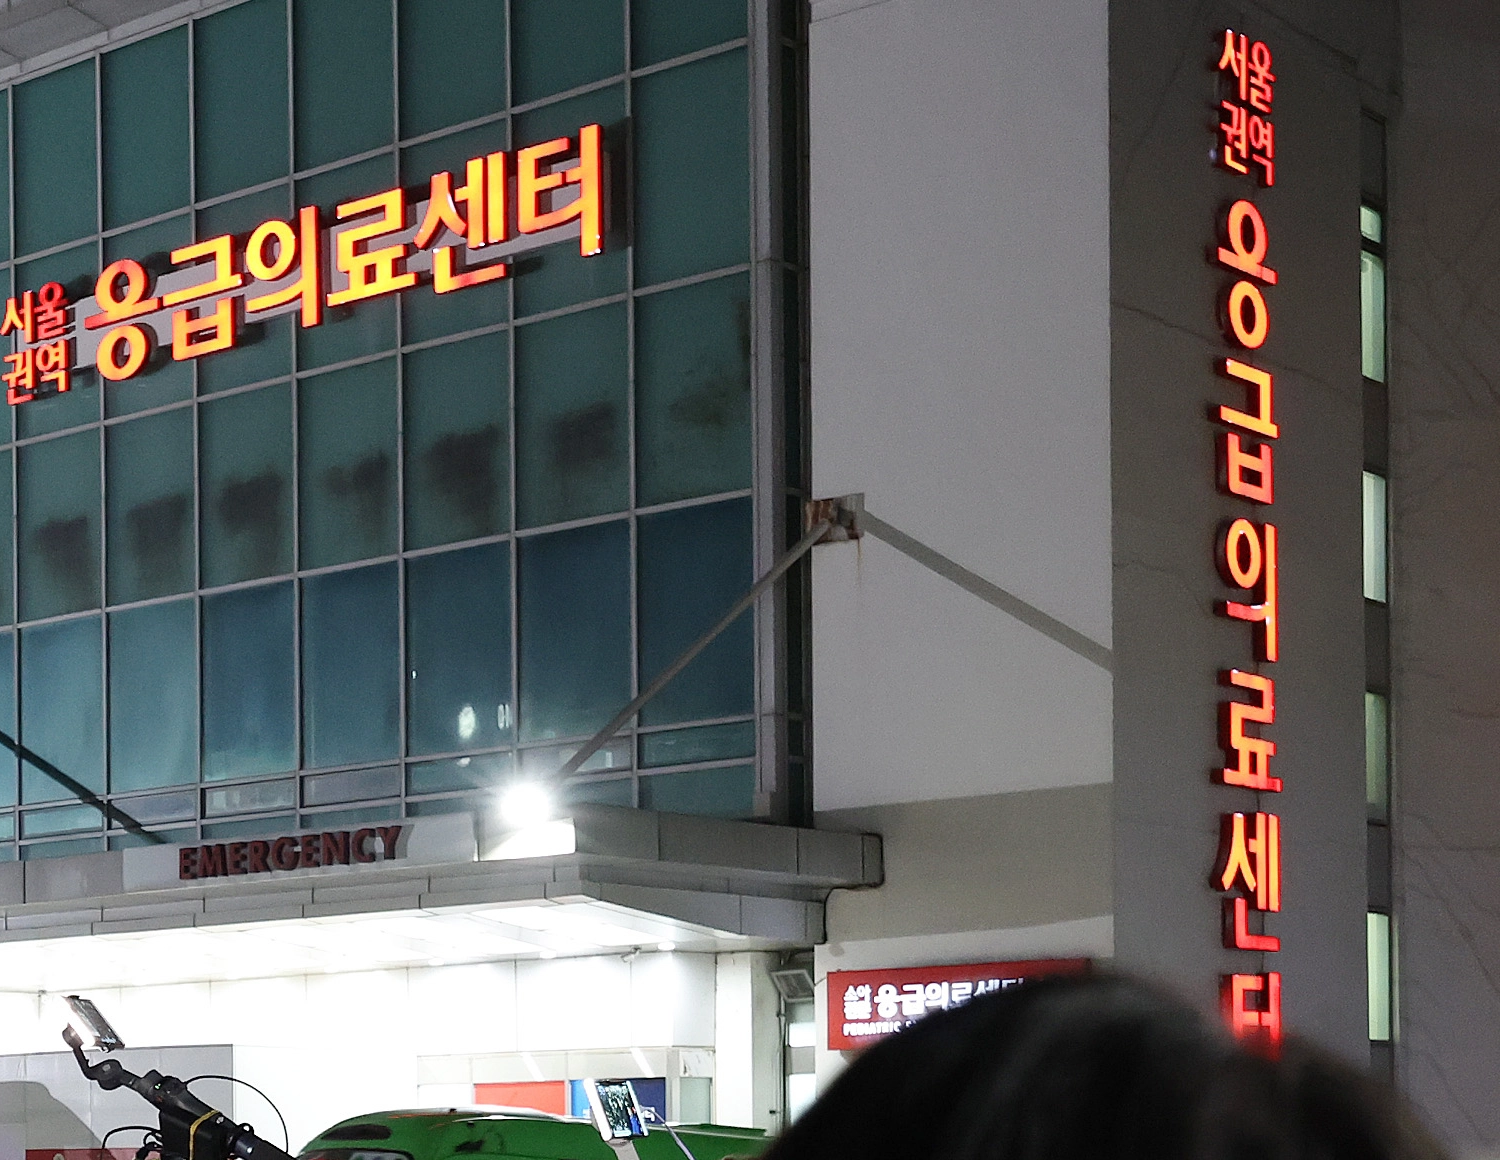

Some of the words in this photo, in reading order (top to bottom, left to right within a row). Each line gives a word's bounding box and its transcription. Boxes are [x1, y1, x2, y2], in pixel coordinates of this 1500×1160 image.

[1219, 28, 1276, 113] 서울
[1220, 100, 1276, 187] 권역
[83, 122, 604, 382] 응급의료센터
[0, 281, 68, 344] 서울
[0, 338, 70, 406] 권역
[1215, 199, 1283, 1050] 응급의료센터
[178, 825, 404, 880] EMERGENCY
[843, 1020, 902, 1037] PEDIATRIC
[873, 977, 1024, 1019] 응급의료
